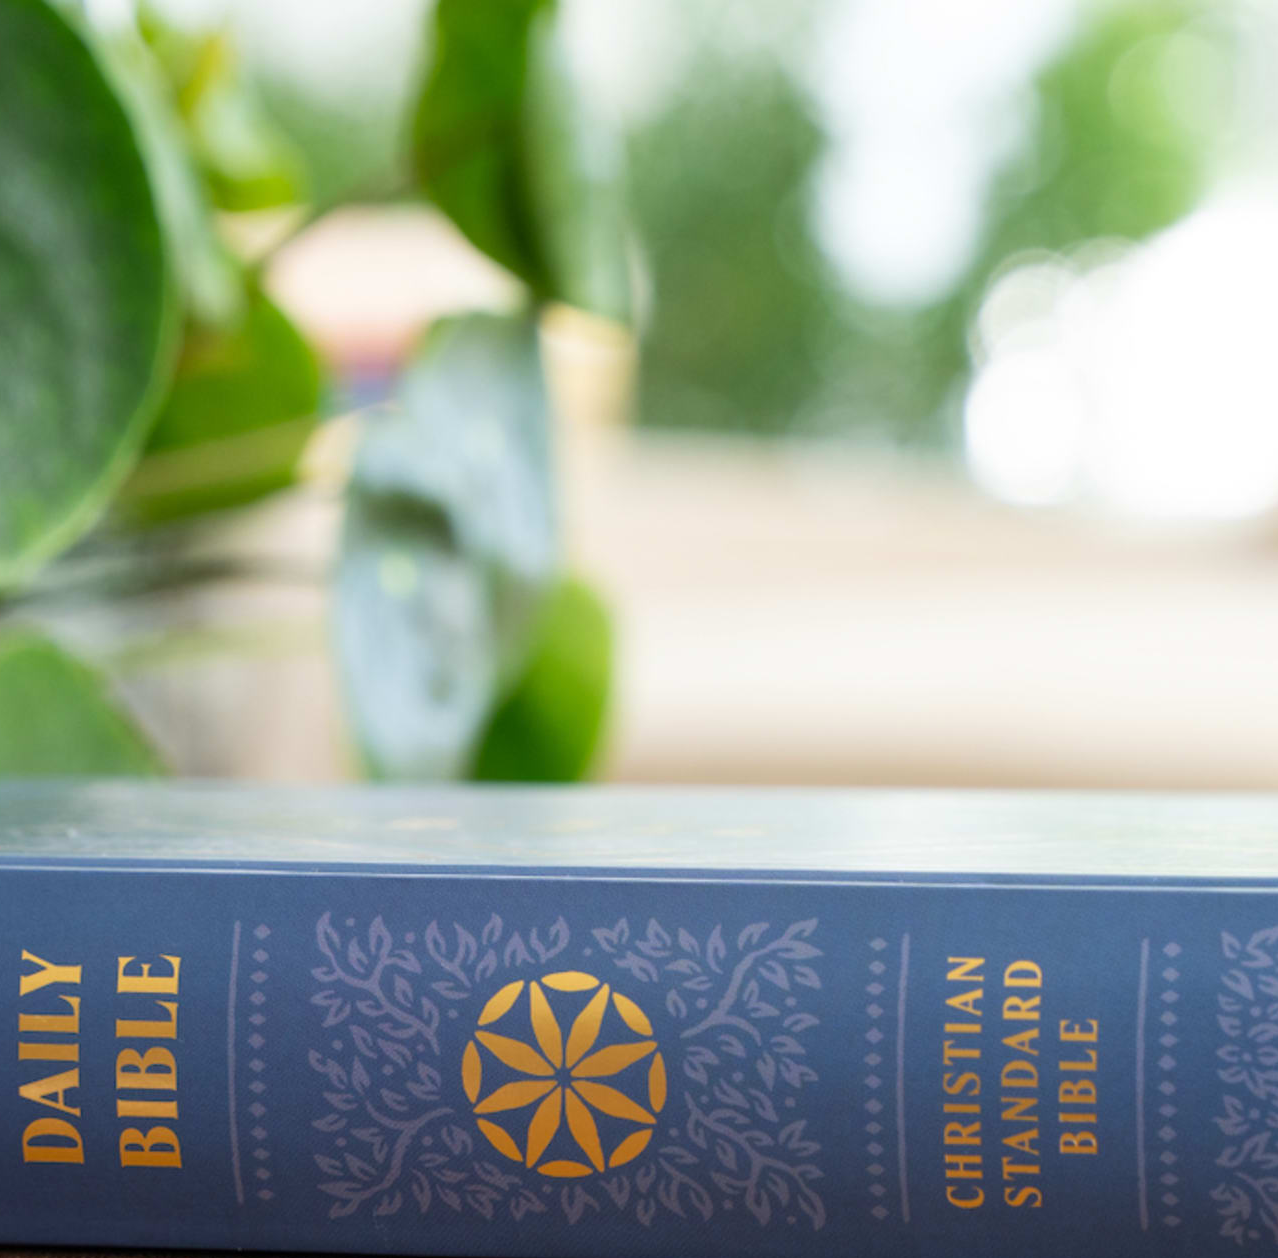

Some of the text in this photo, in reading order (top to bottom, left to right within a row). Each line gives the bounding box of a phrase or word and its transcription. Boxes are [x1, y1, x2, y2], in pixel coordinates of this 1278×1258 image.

[18, 950, 85, 1164] DAILY
[115, 954, 183, 1169] BIBLE
[943, 956, 986, 1209] CHRISTIAN
[1002, 959, 1043, 1207] STANDARD
[1058, 1018, 1099, 1156] BIBLE
